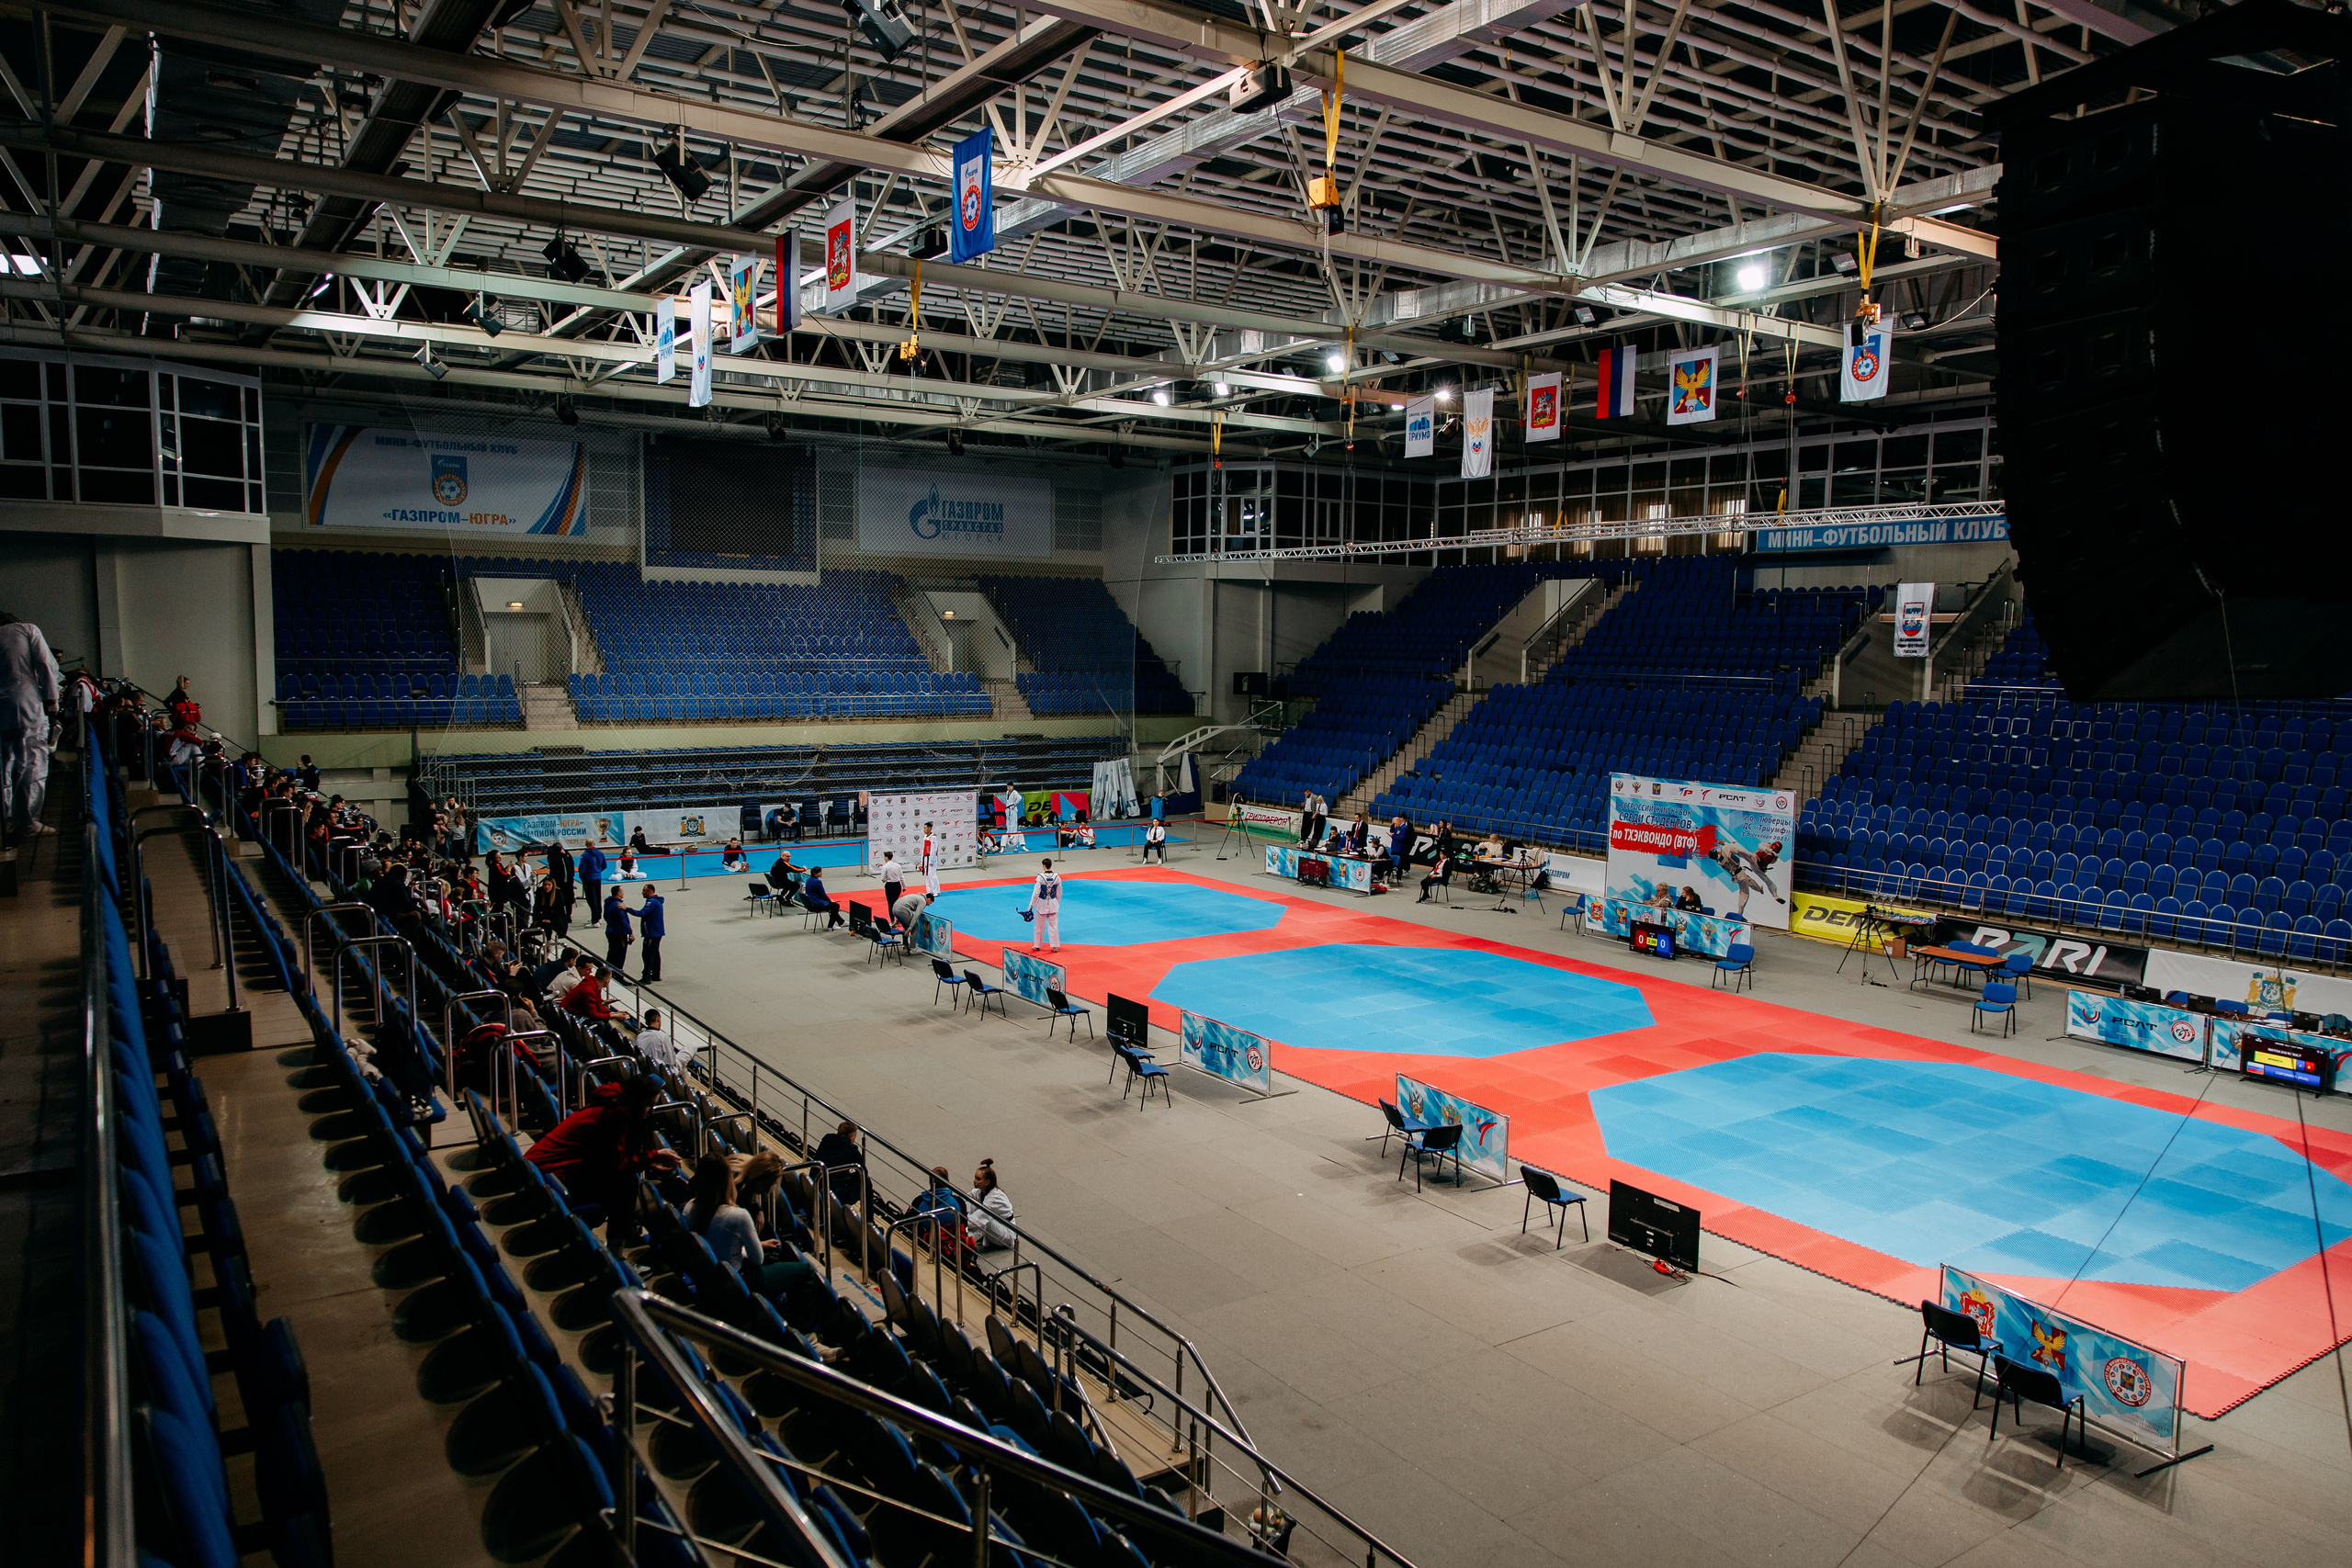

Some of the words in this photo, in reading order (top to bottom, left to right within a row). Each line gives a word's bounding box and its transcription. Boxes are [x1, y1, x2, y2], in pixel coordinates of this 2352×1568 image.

[1408, 431, 1430, 441] ТРИУМФ
[942, 500, 1004, 522] ГАЗПРОМ
[1768, 519, 1948, 548] МИНИ-ФУТБОЛЬНЫЙ
[1953, 520, 2007, 540] КЛУБ
[1620, 802, 1670, 814] ВСЕРОССИЙСКИЙ
[1670, 808, 1692, 817] КУБОК
[1619, 811, 1645, 825] СРЕДИ
[1645, 815, 1692, 829] СТУДЕНТОВ
[1757, 815, 1792, 827] Люберцы
[557, 828, 587, 837] РОССИИ
[1612, 829, 1623, 840] по
[1624, 829, 1673, 849] ТХЭКВОНДО
[1674, 834, 1698, 852] (ВТФ)
[1549, 869, 1570, 879] ГАЗПРОМ
[1638, 934, 1645, 944] 0
[1660, 939, 1666, 949] 0
[1970, 926, 2108, 976] PARI
